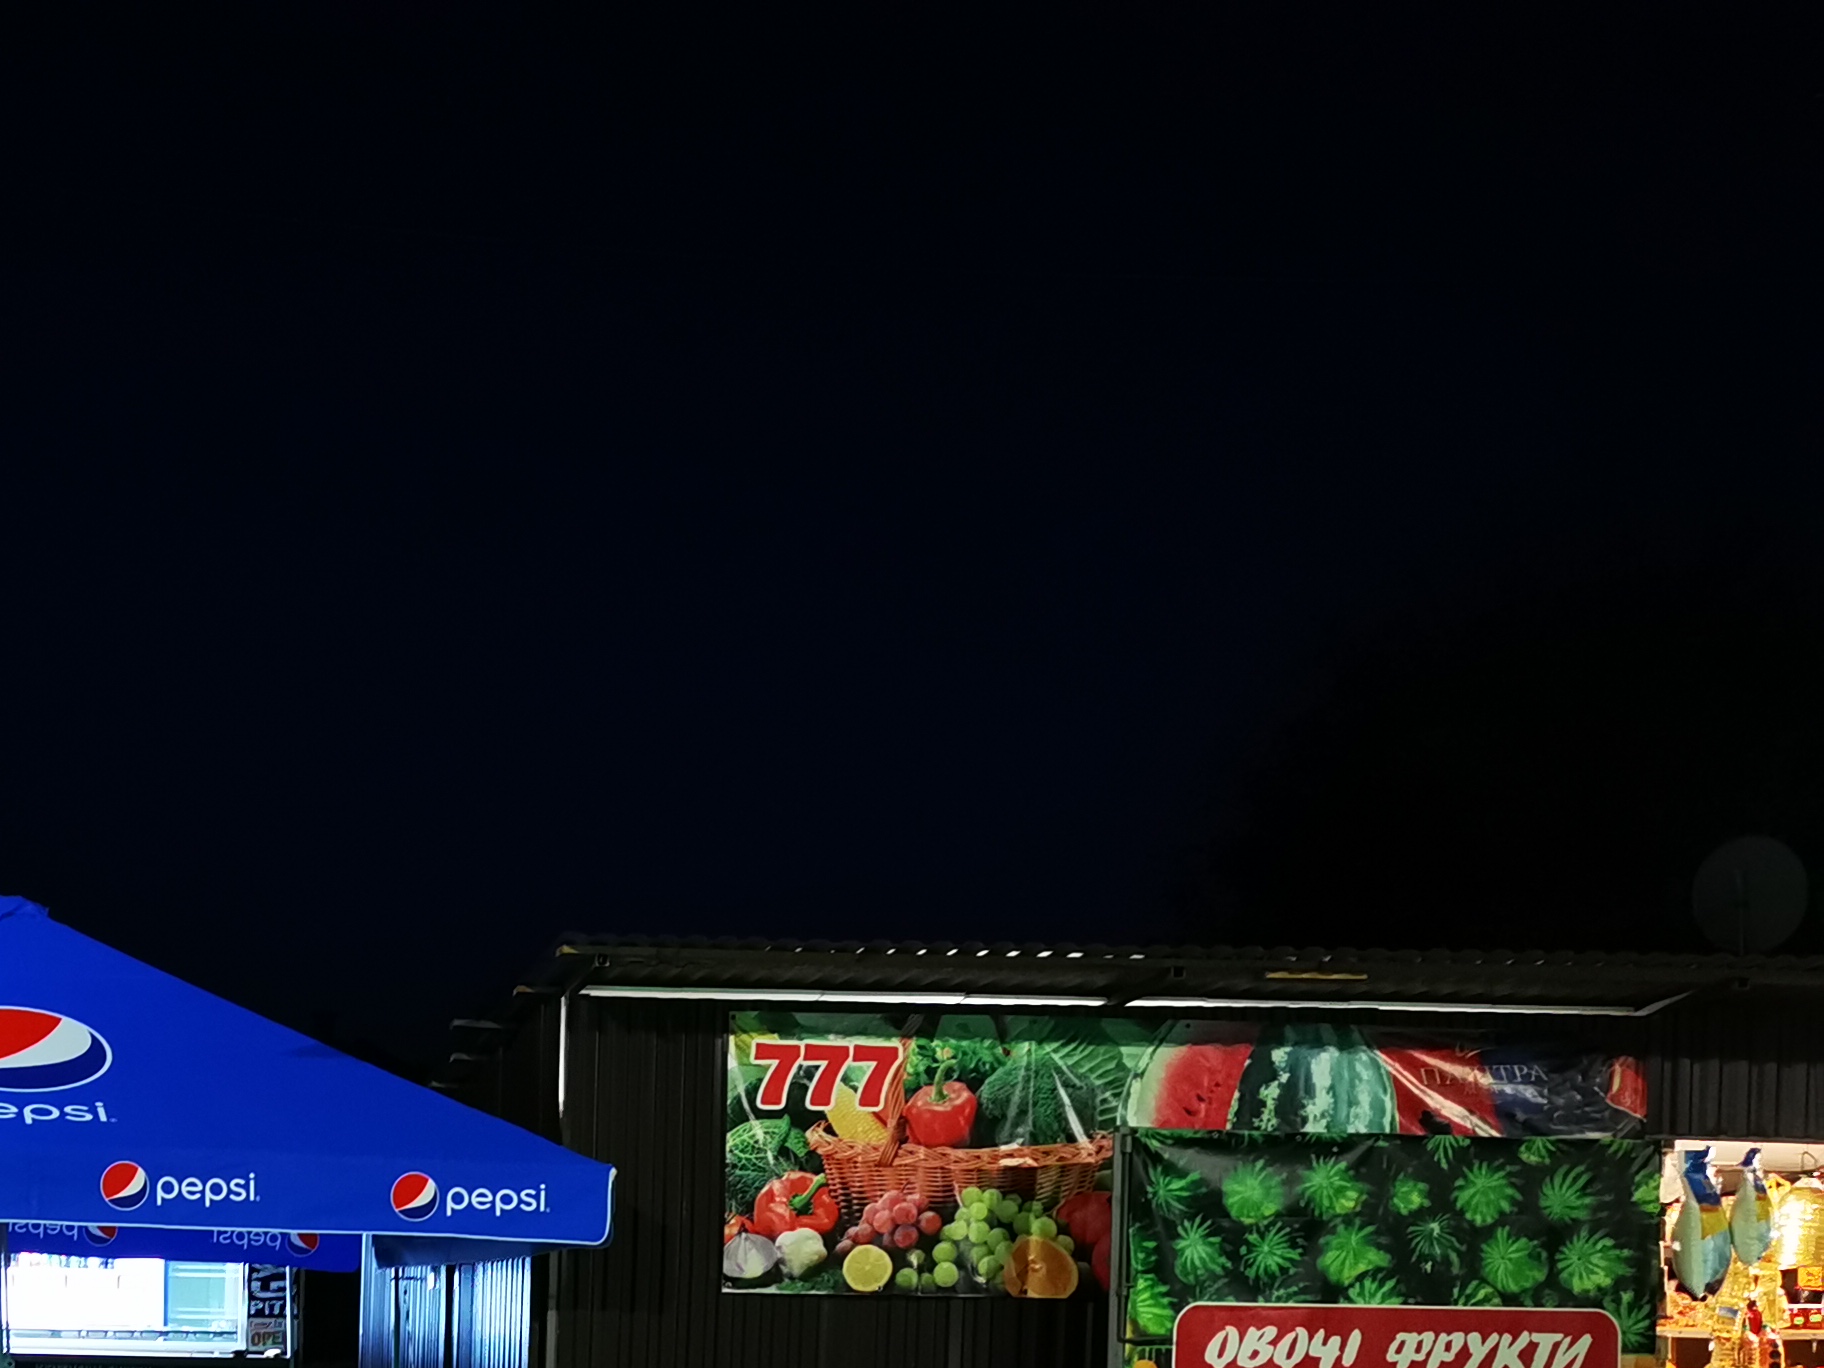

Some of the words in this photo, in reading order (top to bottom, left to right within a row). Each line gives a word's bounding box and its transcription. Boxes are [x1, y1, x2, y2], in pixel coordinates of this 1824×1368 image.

[751, 1039, 902, 1109] 777
[156, 1173, 257, 1208] pepsi
[446, 1184, 547, 1217] pepsi
[251, 1331, 284, 1347] OPE
